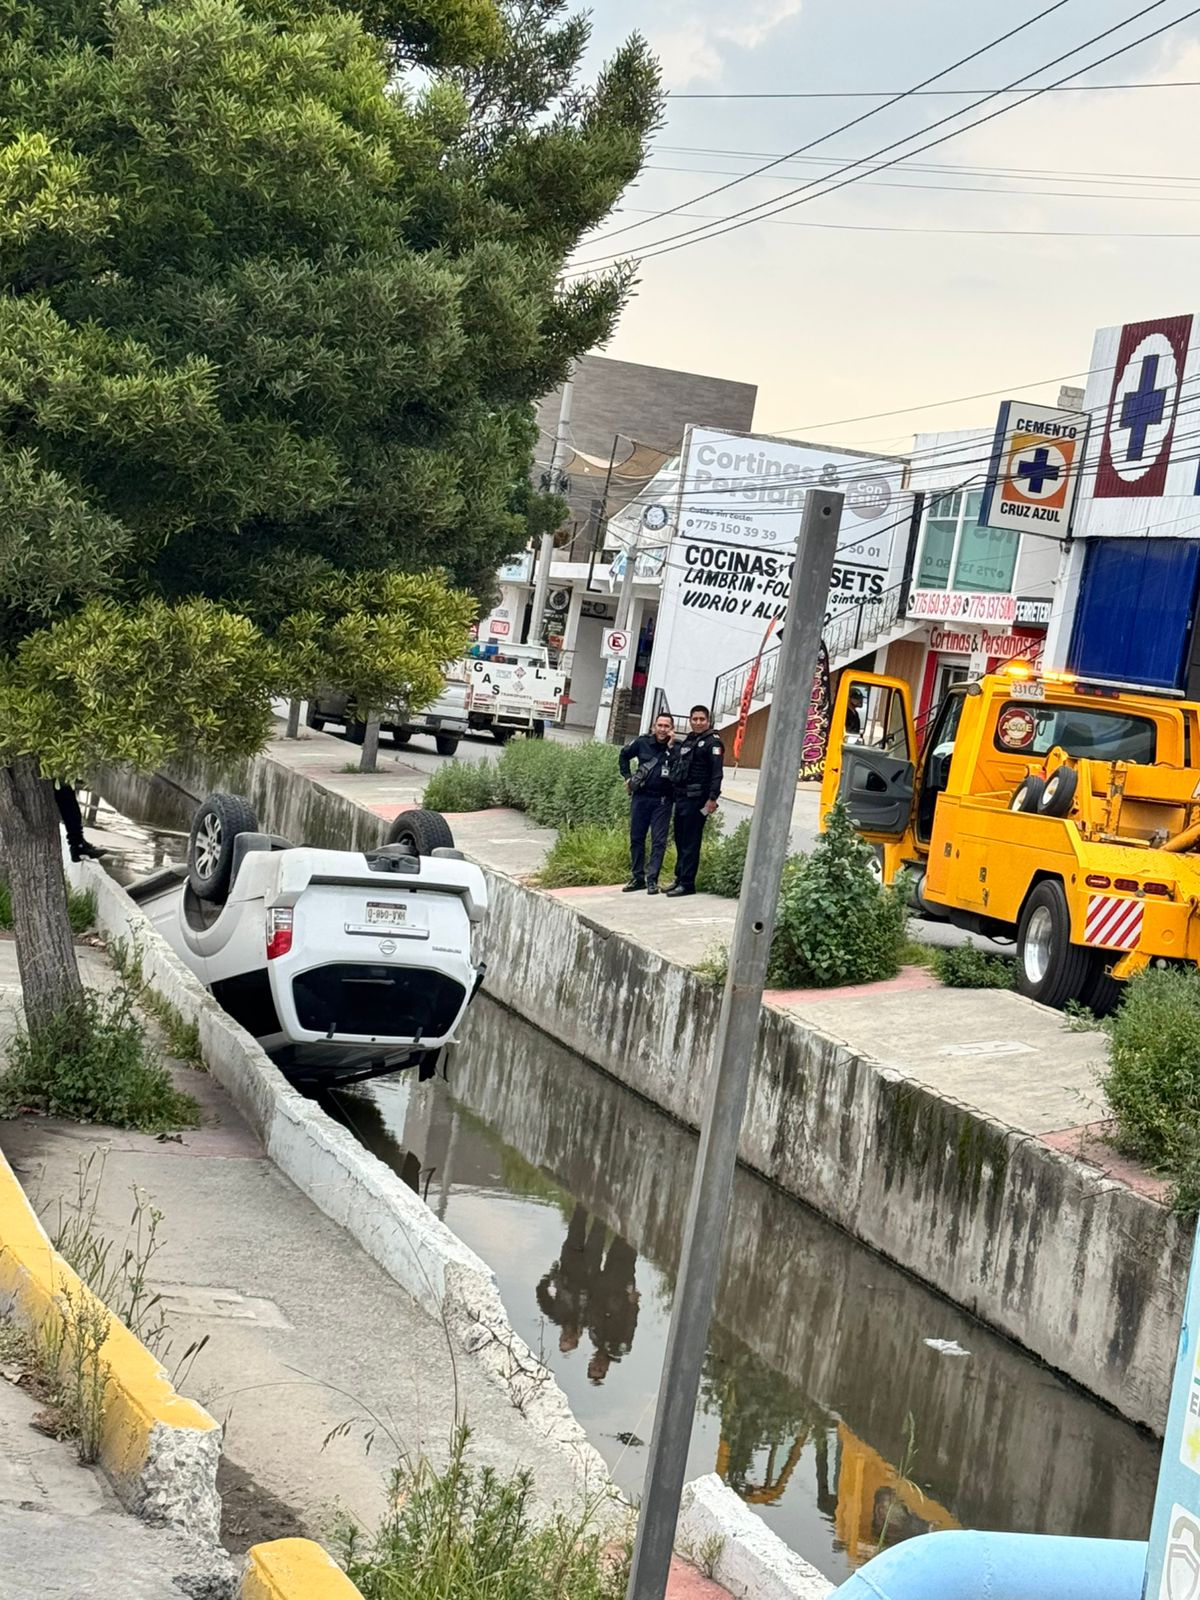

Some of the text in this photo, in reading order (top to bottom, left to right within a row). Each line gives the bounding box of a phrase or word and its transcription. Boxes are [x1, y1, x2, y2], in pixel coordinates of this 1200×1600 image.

[1016, 419, 1077, 439] CEMENTO
[697, 445, 840, 488] Cortinas &
[1000, 502, 1060, 522] CRUZ AZUL
[695, 519, 777, 541] 775 150 39 39
[685, 545, 777, 578] COCINAS
[868, 546, 880, 558] 01
[684, 567, 756, 593] LAMBRIN
[682, 590, 738, 613] VIDRIO
[740, 599, 752, 615] Y
[612, 636, 621, 647] E
[930, 626, 1031, 657] Cortinas & Persianas
[1002, 721, 1033, 732] ACME
